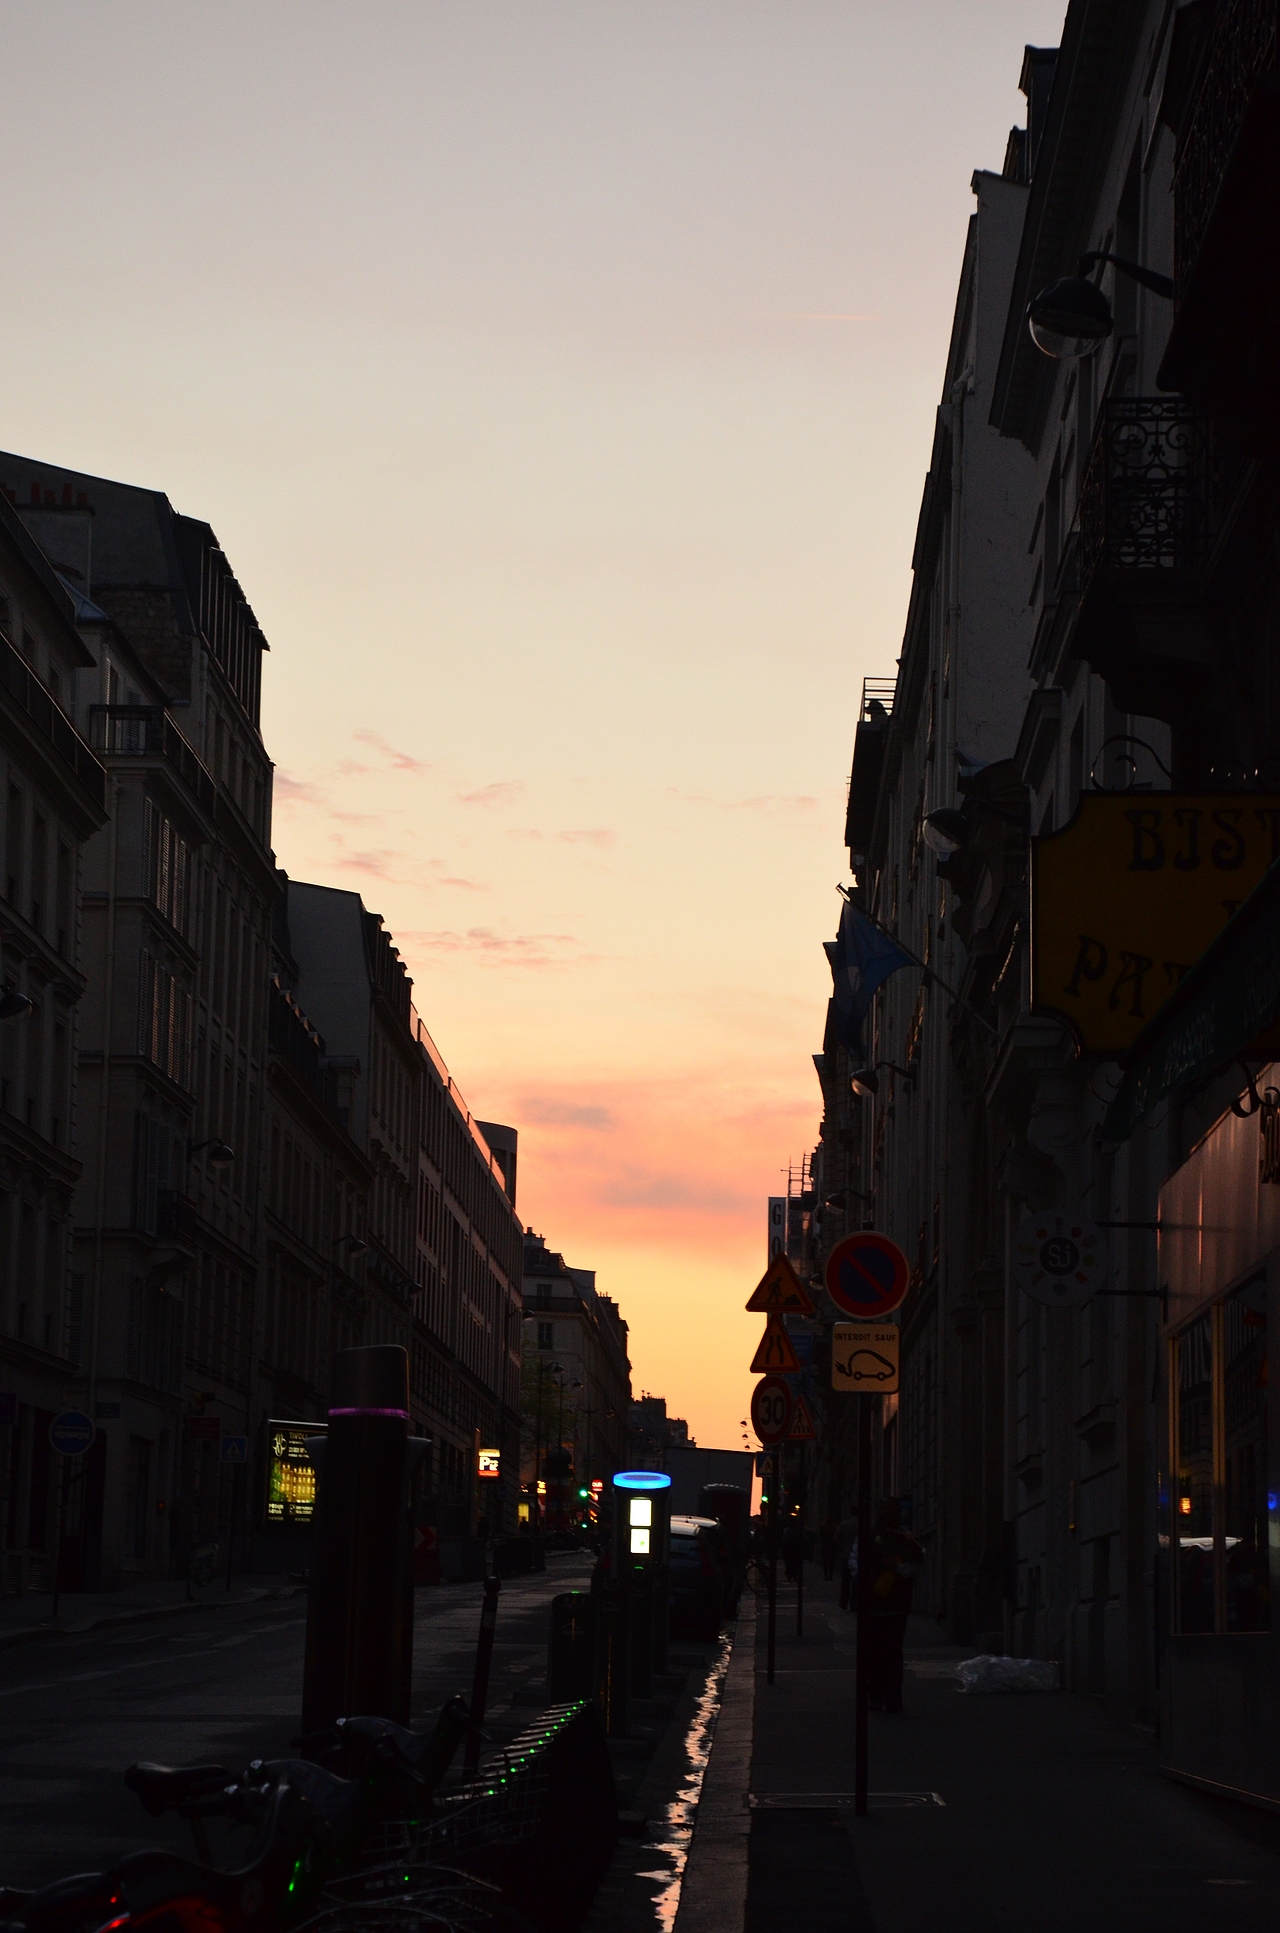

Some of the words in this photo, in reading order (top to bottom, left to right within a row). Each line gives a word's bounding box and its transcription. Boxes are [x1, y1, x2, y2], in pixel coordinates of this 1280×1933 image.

[834, 1333, 871, 1342] INTERDIT
[875, 1333, 897, 1342] SAUF
[760, 1396, 785, 1426] 30
